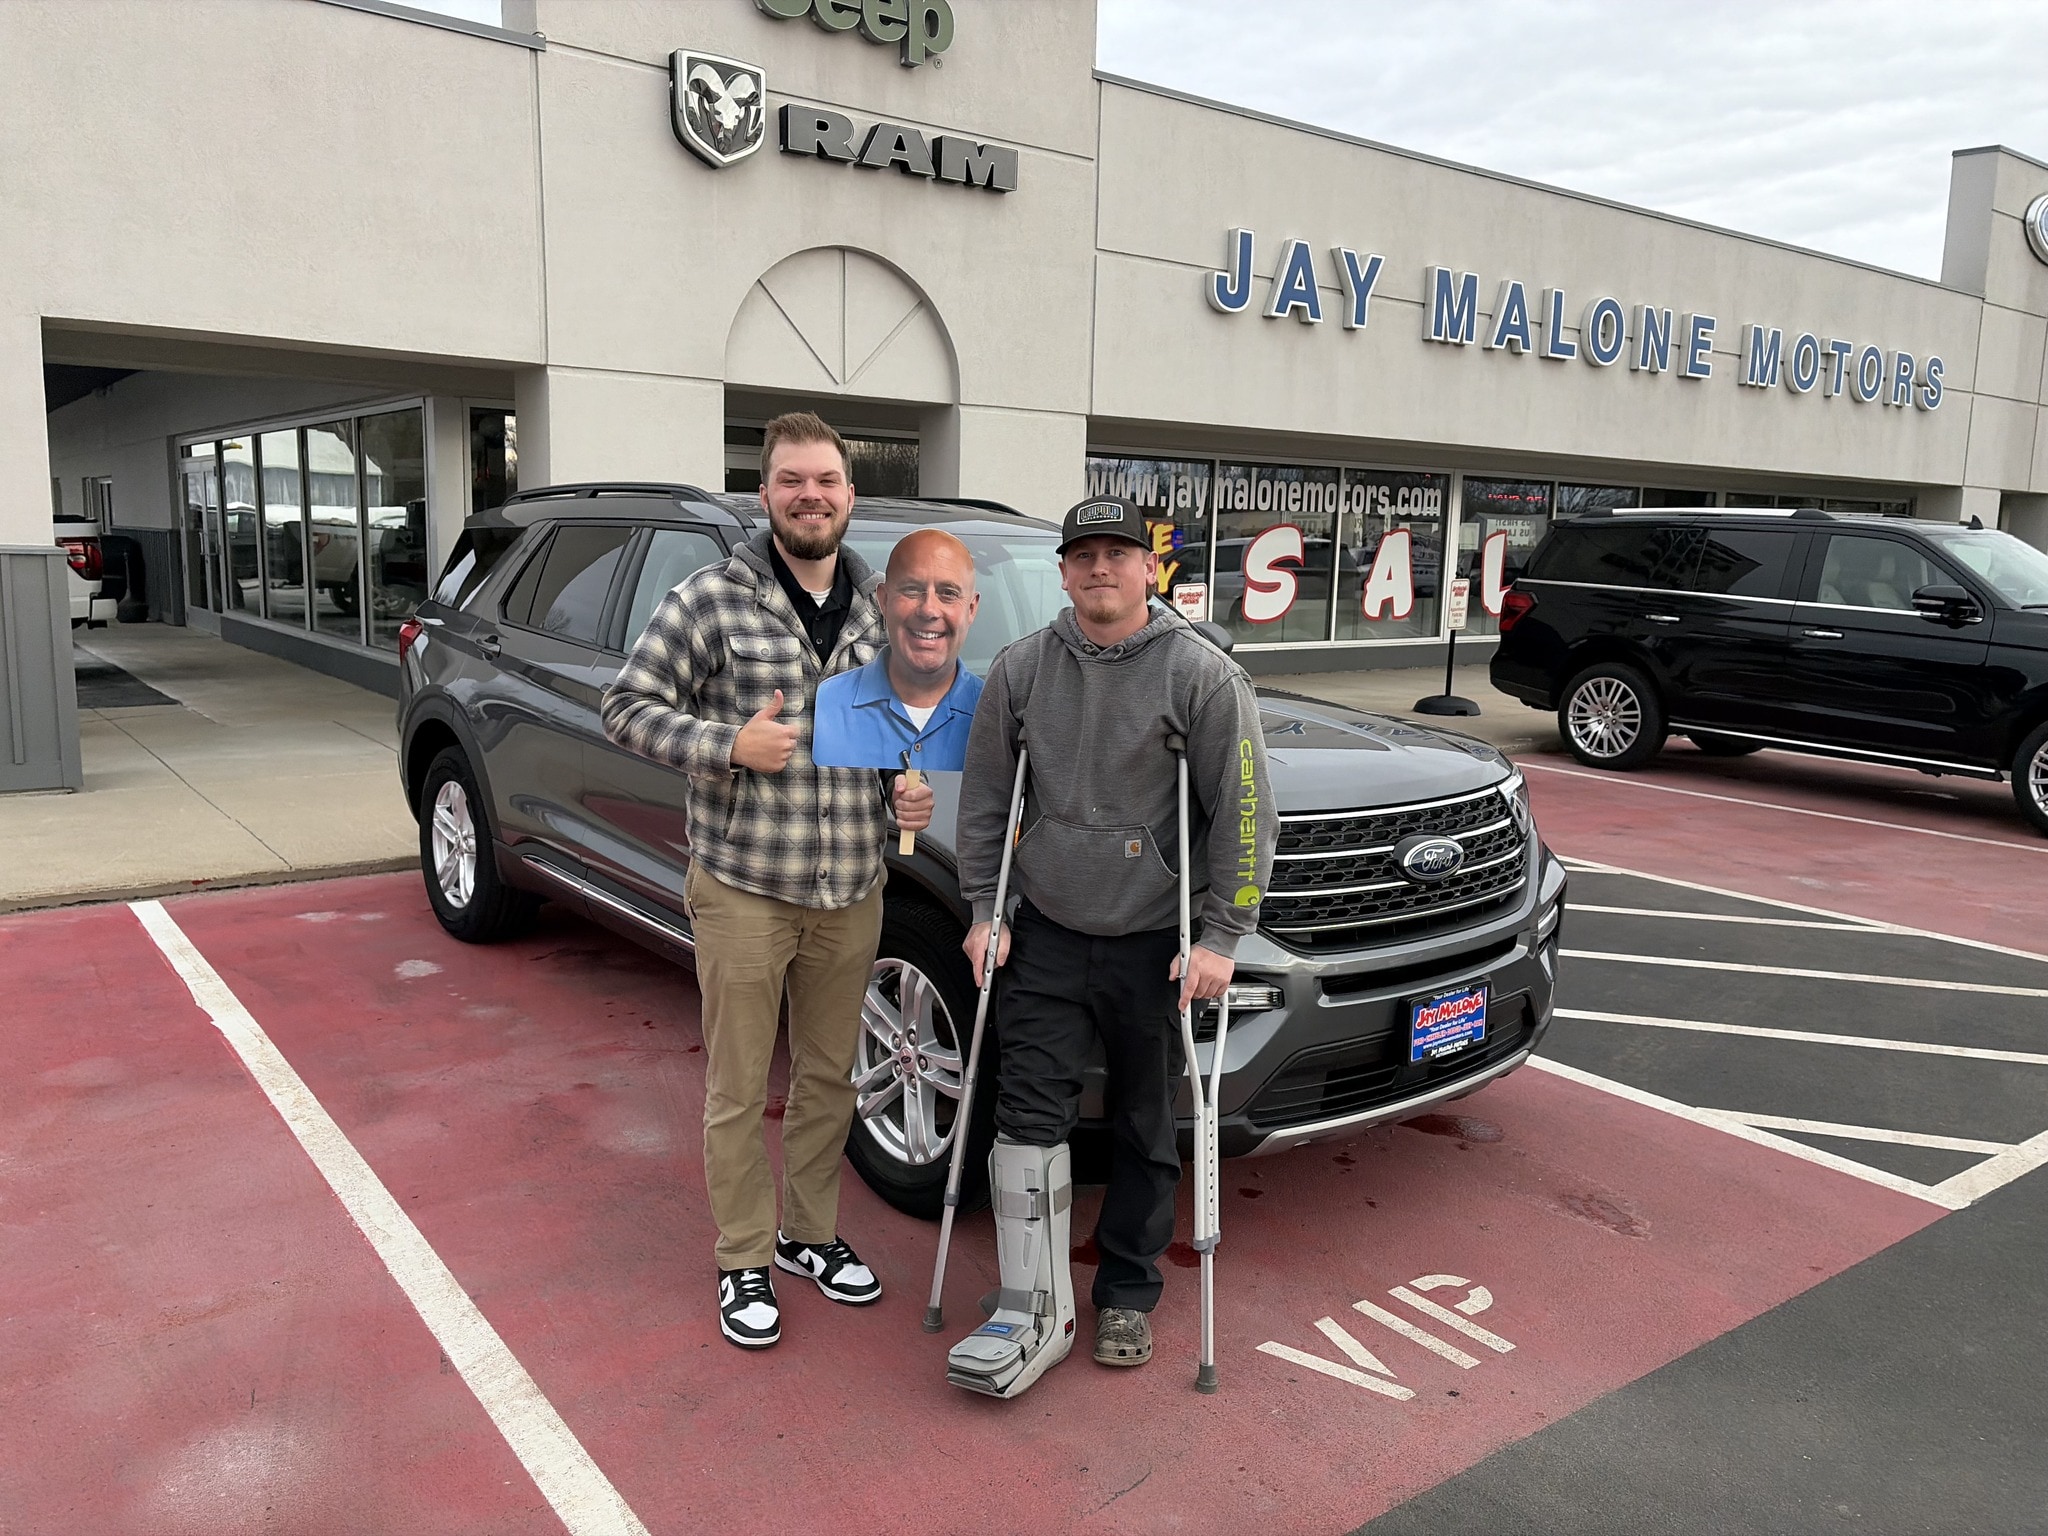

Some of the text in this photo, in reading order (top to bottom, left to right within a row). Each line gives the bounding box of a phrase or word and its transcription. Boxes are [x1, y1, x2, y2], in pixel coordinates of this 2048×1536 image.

[779, 103, 1018, 194] RAM
[1205, 228, 1944, 411] JAY MALONE MOTORS
[1085, 465, 1442, 519] www.jaymalonemotors.com
[1241, 523, 1513, 623] SAL
[1237, 738, 1259, 881] carhartt
[1422, 847, 1454, 872] Ford
[1416, 991, 1484, 1028] JAY MALONE
[1255, 1274, 1517, 1401] VIP
